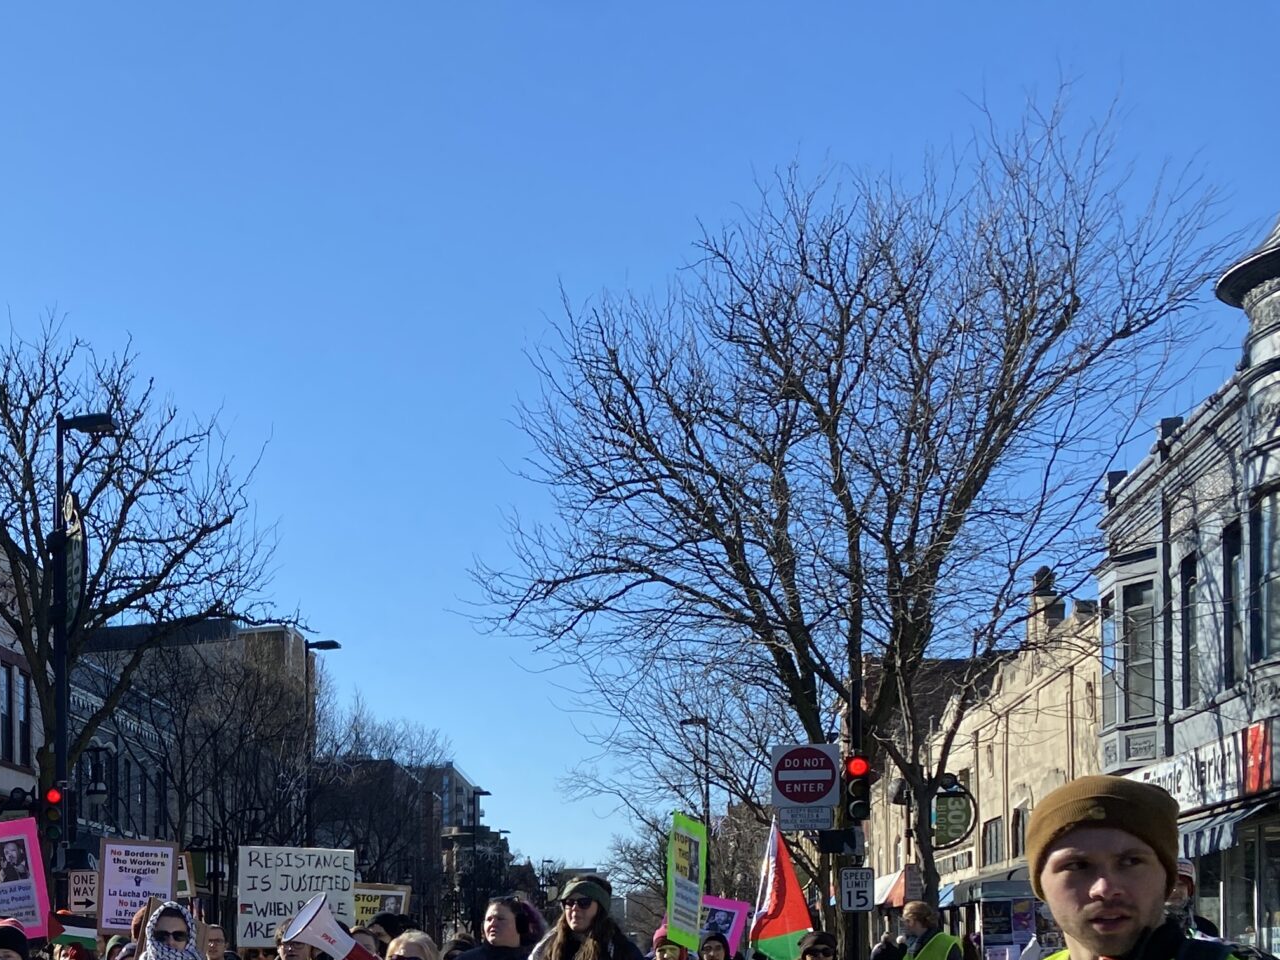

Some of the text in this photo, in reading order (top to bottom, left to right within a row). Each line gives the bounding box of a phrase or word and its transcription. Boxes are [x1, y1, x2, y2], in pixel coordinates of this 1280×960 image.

[784, 757, 826, 768] DO NOT
[785, 783, 825, 793] ENTER
[948, 797, 966, 838] 300
[124, 850, 159, 858] Borders
[160, 851, 169, 859] in
[129, 858, 165, 867] Workers
[248, 851, 354, 872] RESISTANCE
[118, 865, 159, 875] Struggle!
[73, 874, 96, 885] ONE
[844, 871, 871, 880] SPEED
[246, 874, 351, 892] IS JUSTIFIED
[846, 880, 868, 889] LIMIT
[73, 887, 96, 897] WAY
[108, 889, 117, 897] La
[118, 889, 140, 898] Lucha
[354, 893, 379, 903] STOP
[846, 890, 869, 908] 15
[254, 901, 348, 917] WHEN PLE
[360, 906, 378, 914] THE
[243, 922, 277, 939] ARE
